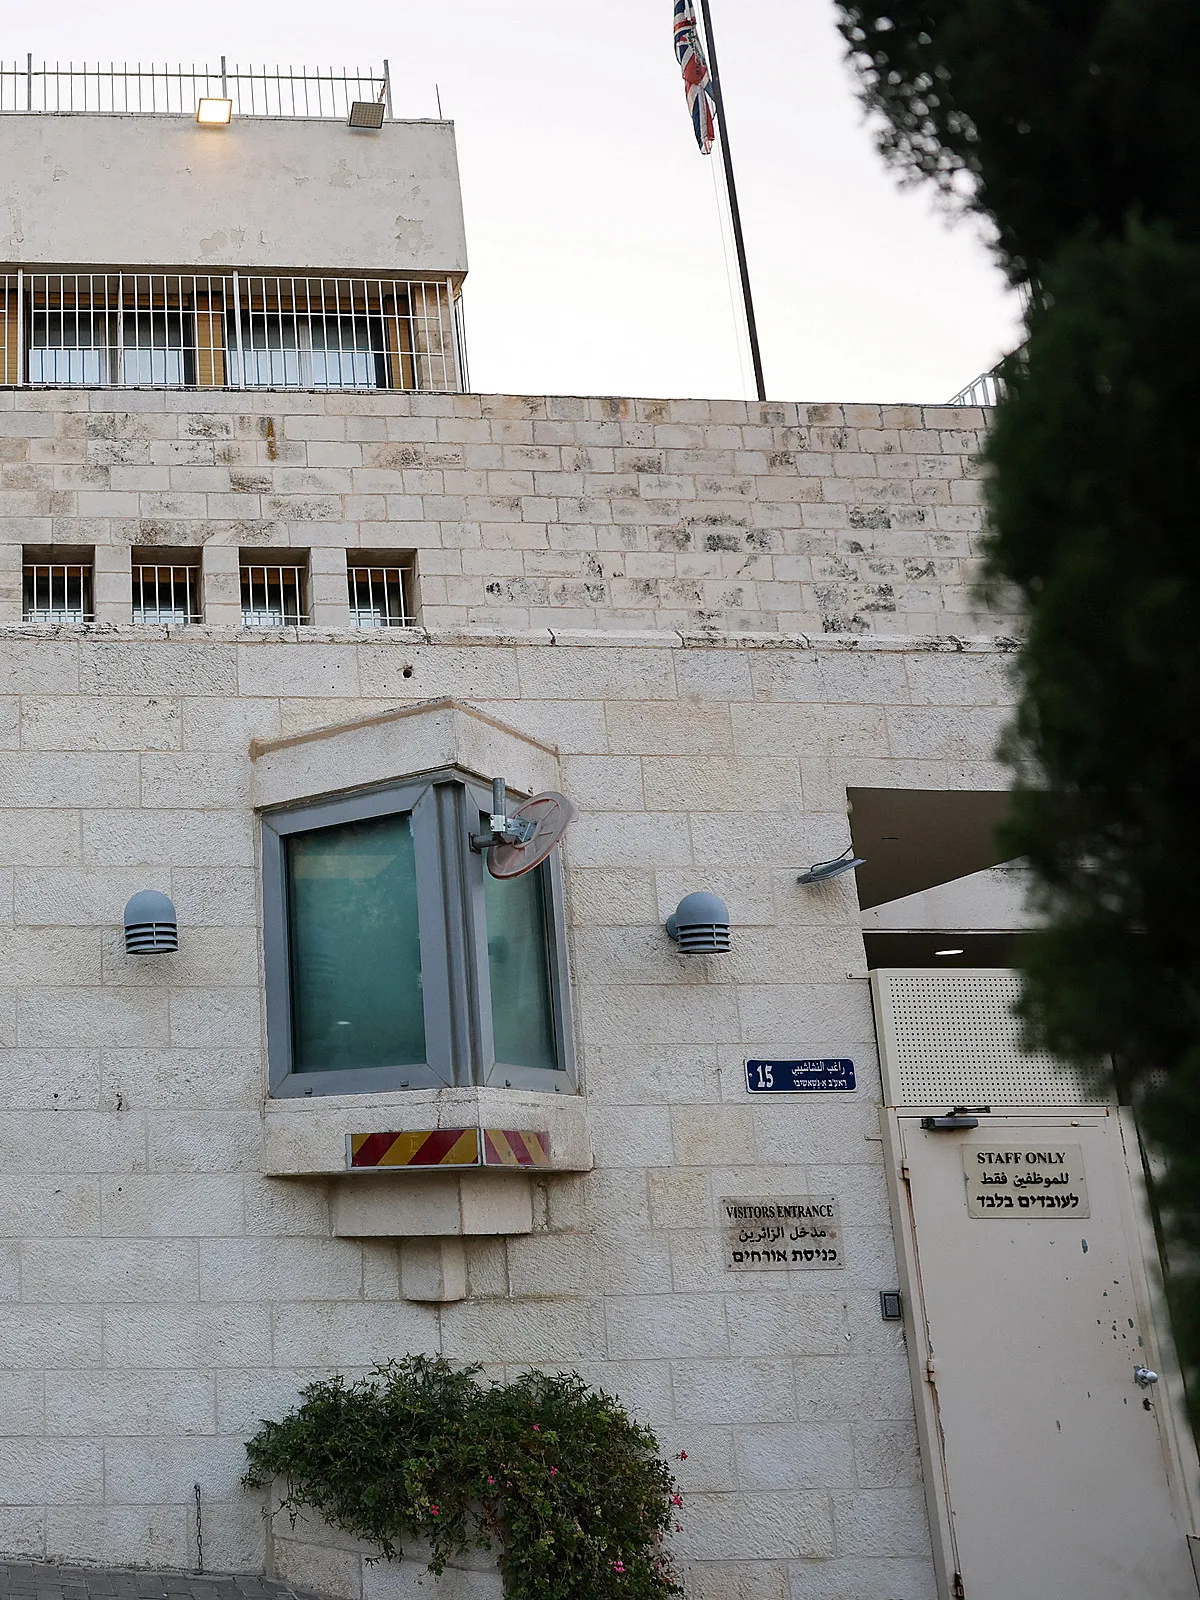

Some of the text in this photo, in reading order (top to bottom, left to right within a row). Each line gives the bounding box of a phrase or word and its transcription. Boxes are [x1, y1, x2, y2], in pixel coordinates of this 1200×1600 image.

[756, 1064, 774, 1088] 15
[791, 1060, 846, 1076] راغب النشاشيبي
[977, 1151, 1066, 1164] STAFF ONLY
[980, 1171, 1070, 1188] للموظفين فقط
[976, 1192, 1079, 1209] לעובדים בלבד
[726, 1204, 834, 1219] VISITORS ENTRANCE
[738, 1226, 827, 1242] مدخل الزائرين
[731, 1248, 838, 1263] כניסת אורחים
